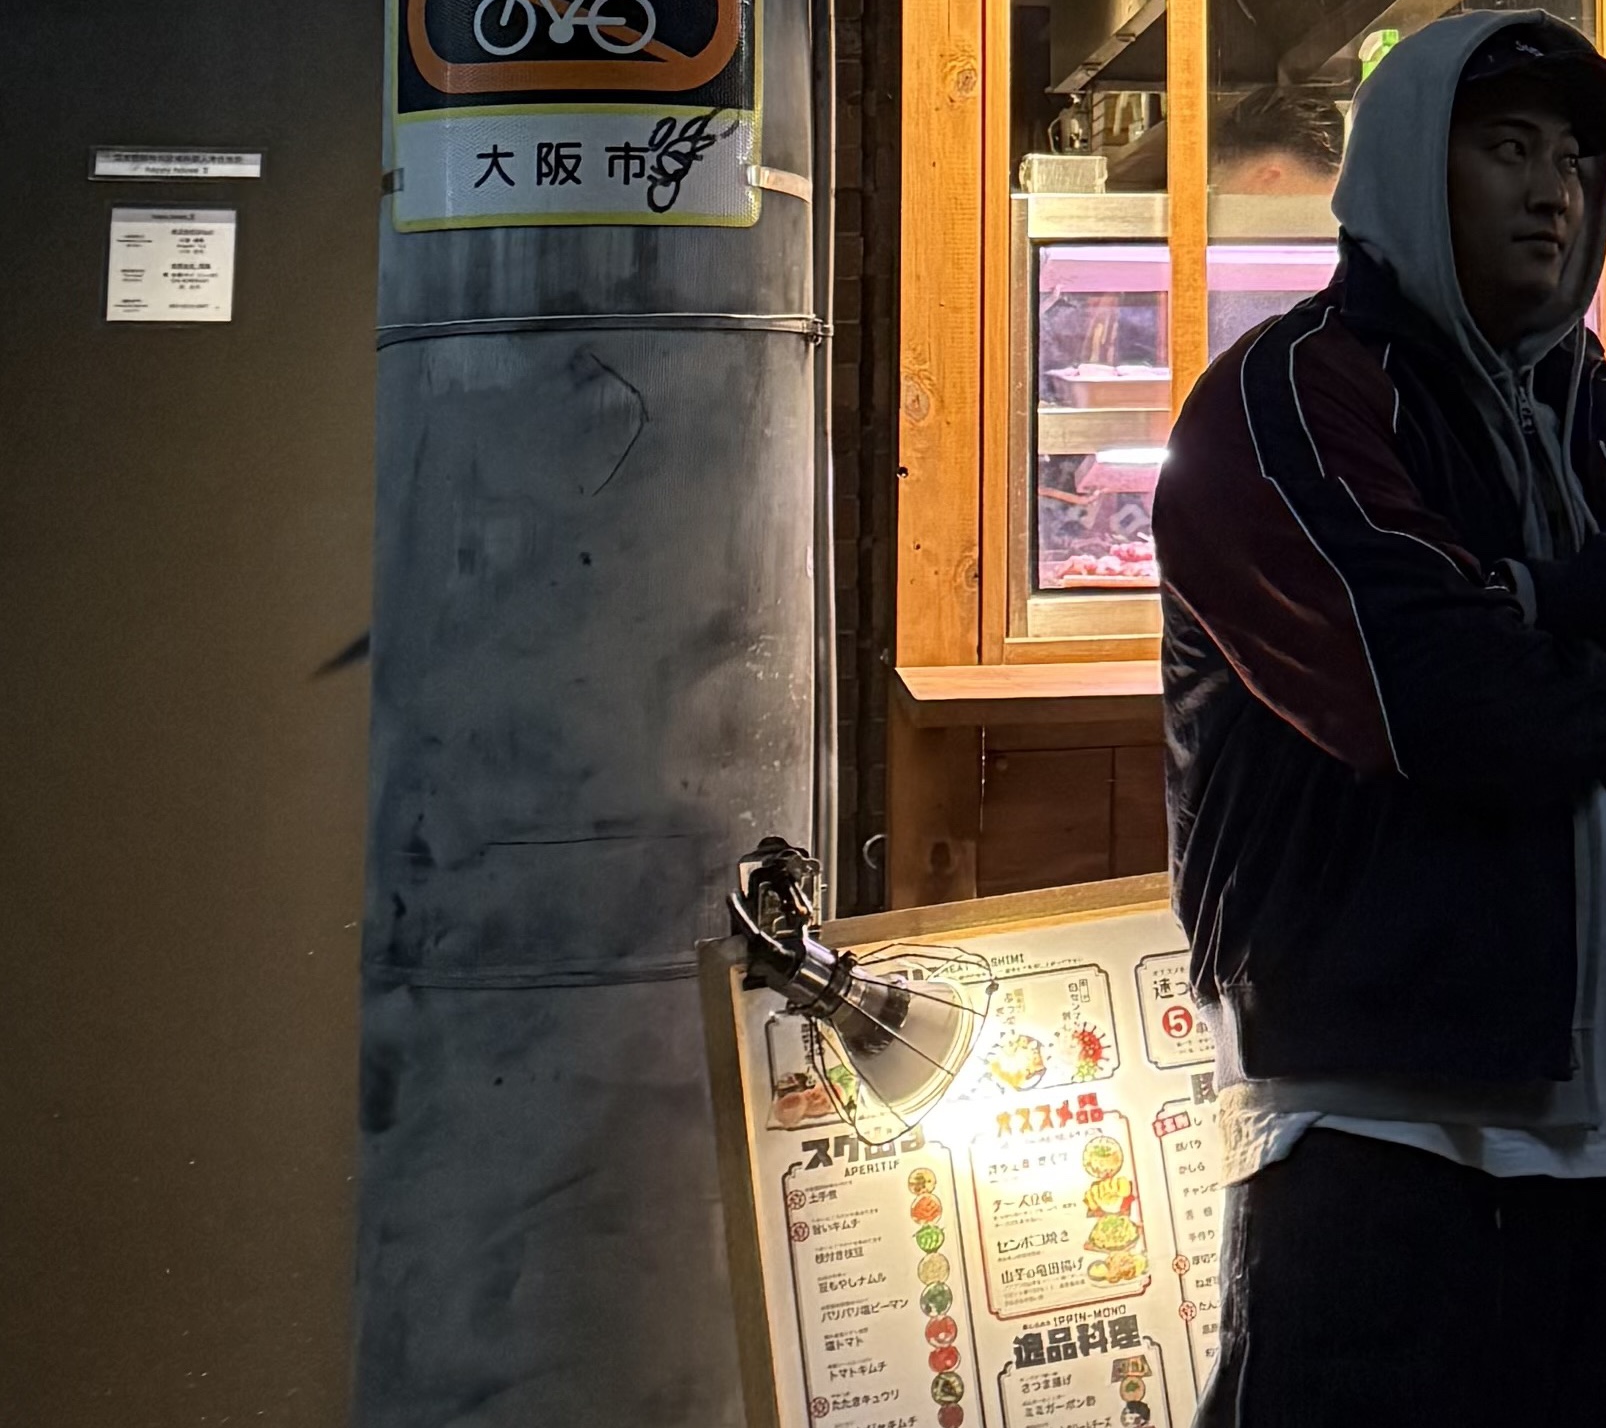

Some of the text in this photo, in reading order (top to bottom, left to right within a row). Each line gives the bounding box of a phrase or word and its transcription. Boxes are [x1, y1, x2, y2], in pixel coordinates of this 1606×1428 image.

[474, 142, 650, 188] 大阪市
[1163, 1005, 1192, 1040] 5
[996, 1092, 1105, 1133] オススメ品
[842, 1157, 901, 1178] APERITIF
[817, 1269, 887, 1294] 豆もやしナムル
[1000, 1256, 1085, 1285] 山芋の竜田揚げ
[819, 1296, 909, 1323] パリパリ塩ピーマン
[1052, 1303, 1127, 1327] IPPIN-MONO
[823, 1334, 864, 1353] 塩トマト
[1011, 1313, 1141, 1370] 逸品料理
[827, 1359, 888, 1383] トマトキムチ
[1020, 1373, 1073, 1396] さつま揚げ
[830, 1386, 900, 1413] たたきキュウリ
[1023, 1393, 1096, 1419] ミミガーポン酢
